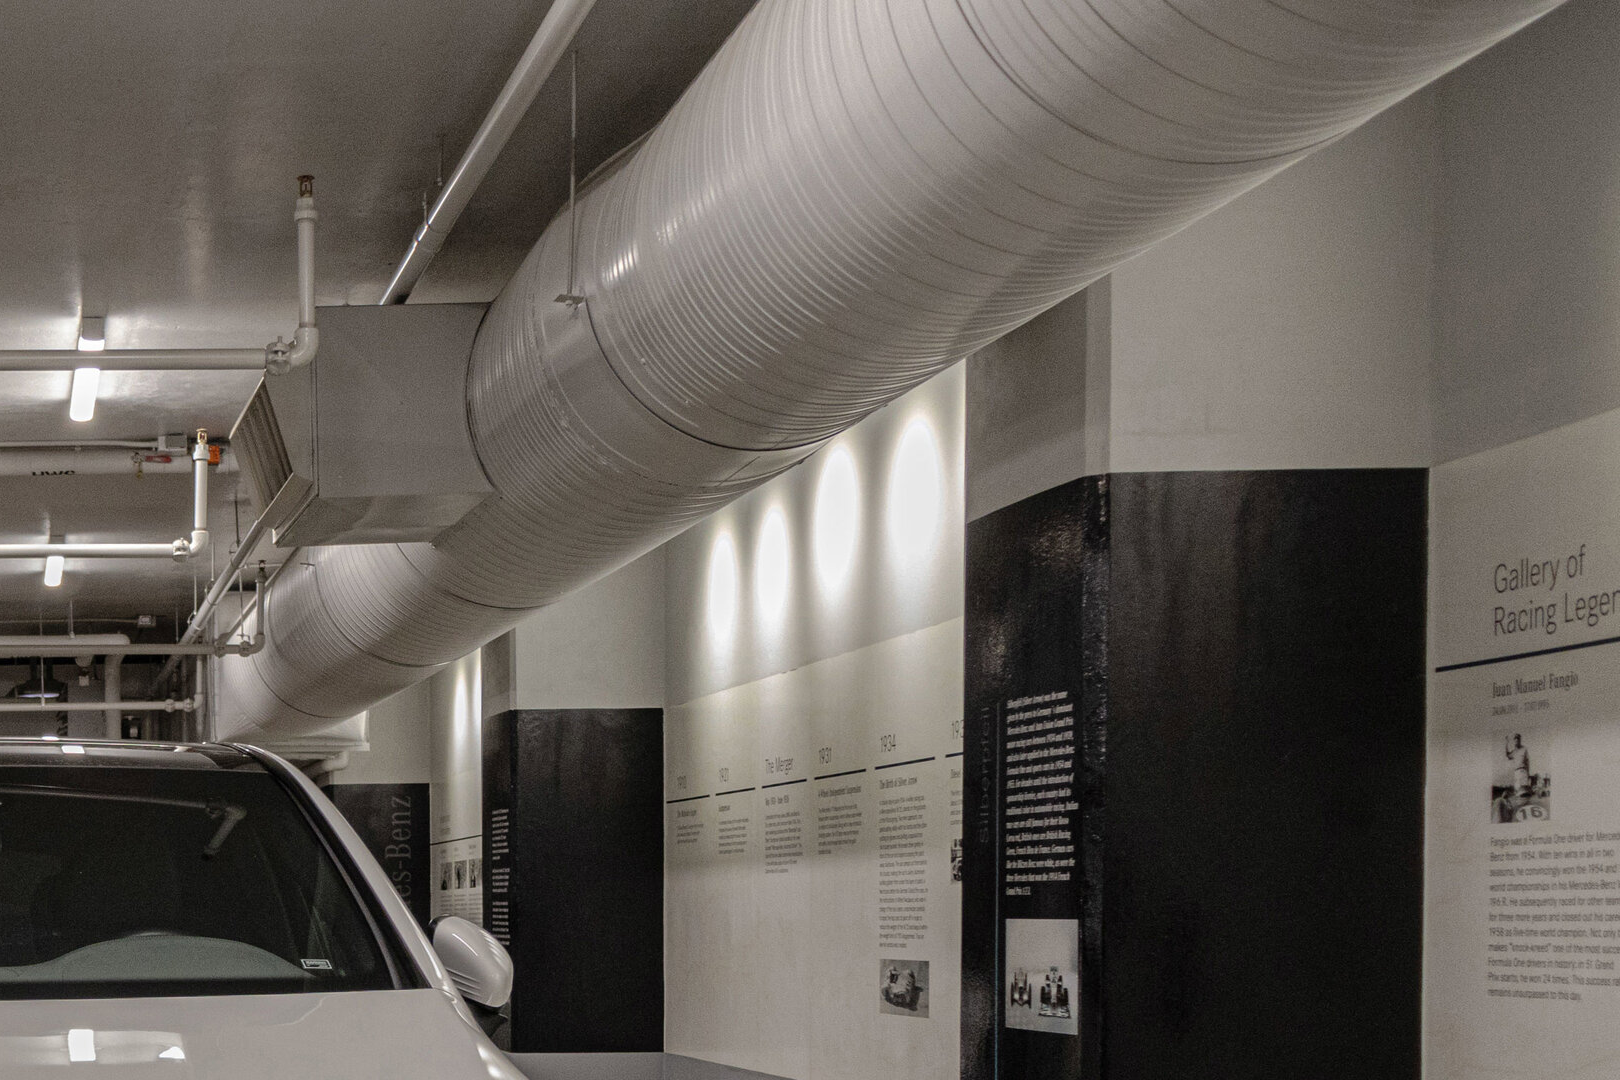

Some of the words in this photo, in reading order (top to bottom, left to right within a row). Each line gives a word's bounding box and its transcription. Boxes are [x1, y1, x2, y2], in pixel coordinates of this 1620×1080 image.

[1494, 557, 1560, 594] Gallery
[1567, 544, 1586, 578] of
[1494, 600, 1557, 636] Racing
[1492, 682, 1512, 698] Juan
[1515, 675, 1546, 695] Manuel
[1549, 670, 1579, 692] Fangio
[951, 720, 963, 740] 193
[880, 734, 896, 753] 1934
[776, 756, 793, 776] Merger
